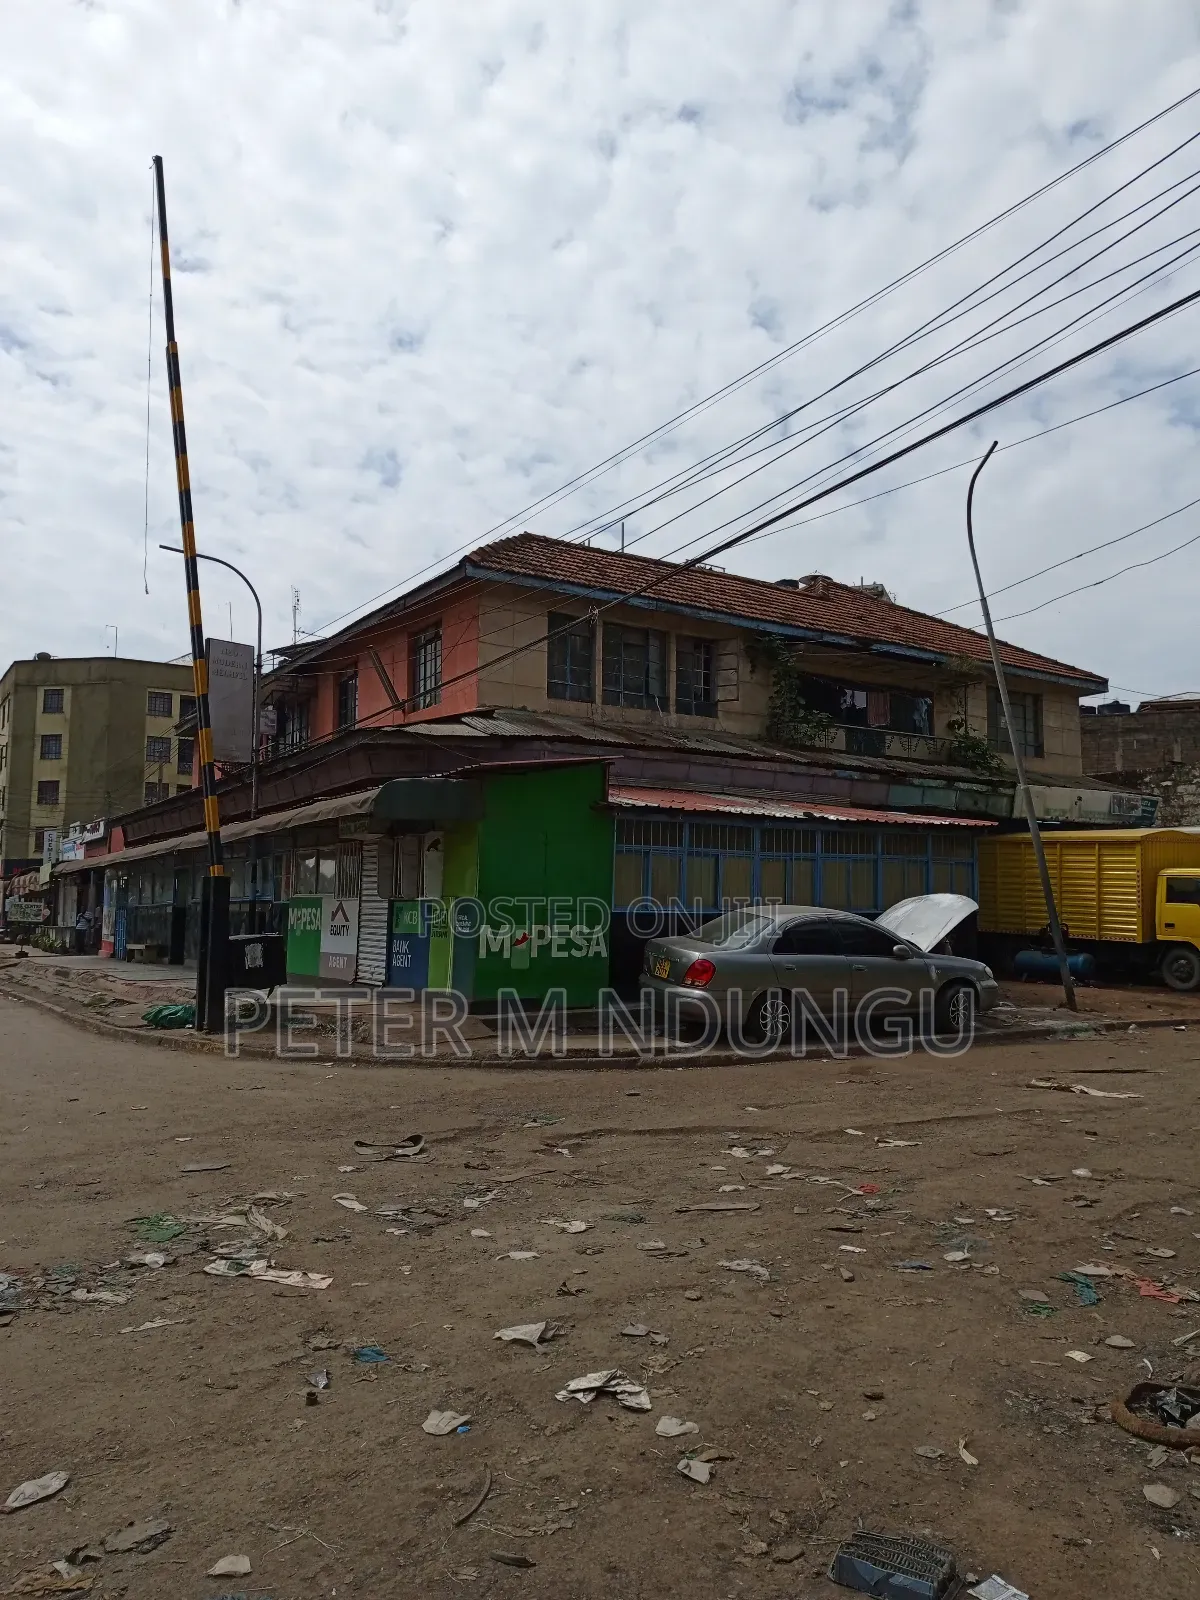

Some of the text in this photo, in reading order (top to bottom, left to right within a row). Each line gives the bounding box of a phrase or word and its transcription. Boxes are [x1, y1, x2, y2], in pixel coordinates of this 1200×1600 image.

[404, 910, 418, 925] KCB
[330, 924, 350, 936] EQUITY
[392, 939, 409, 954] BANK
[328, 955, 348, 969] AGENT
[392, 954, 411, 968] AGENT
